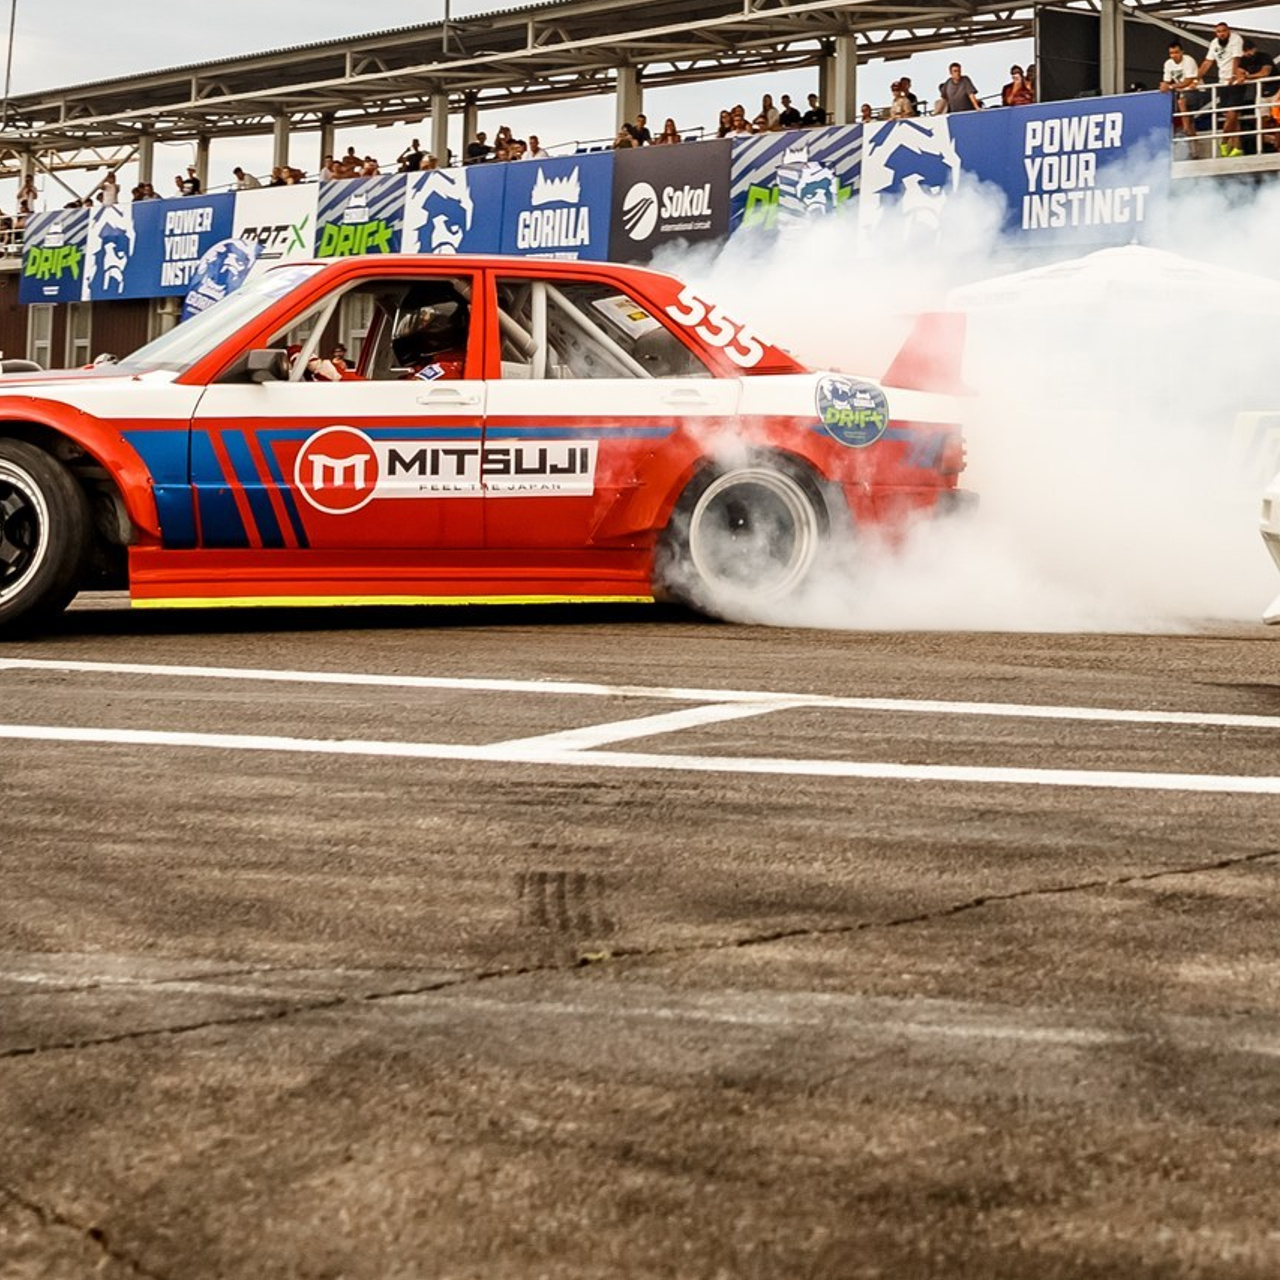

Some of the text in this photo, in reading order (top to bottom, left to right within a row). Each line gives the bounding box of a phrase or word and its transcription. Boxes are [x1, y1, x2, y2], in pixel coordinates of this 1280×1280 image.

[1024, 112, 1123, 156] POWER
[1023, 152, 1096, 193] YOUR
[165, 207, 213, 235] POWER
[1021, 185, 1150, 230] INSTINCT
[317, 220, 393, 257] DRIFT
[517, 207, 590, 249] GORILLA
[25, 245, 82, 280] DRIFT
[164, 234, 199, 260] YOUR
[664, 283, 773, 368] 555
[825, 407, 884, 430] DRIFT
[387, 448, 590, 476] MITSUJI
